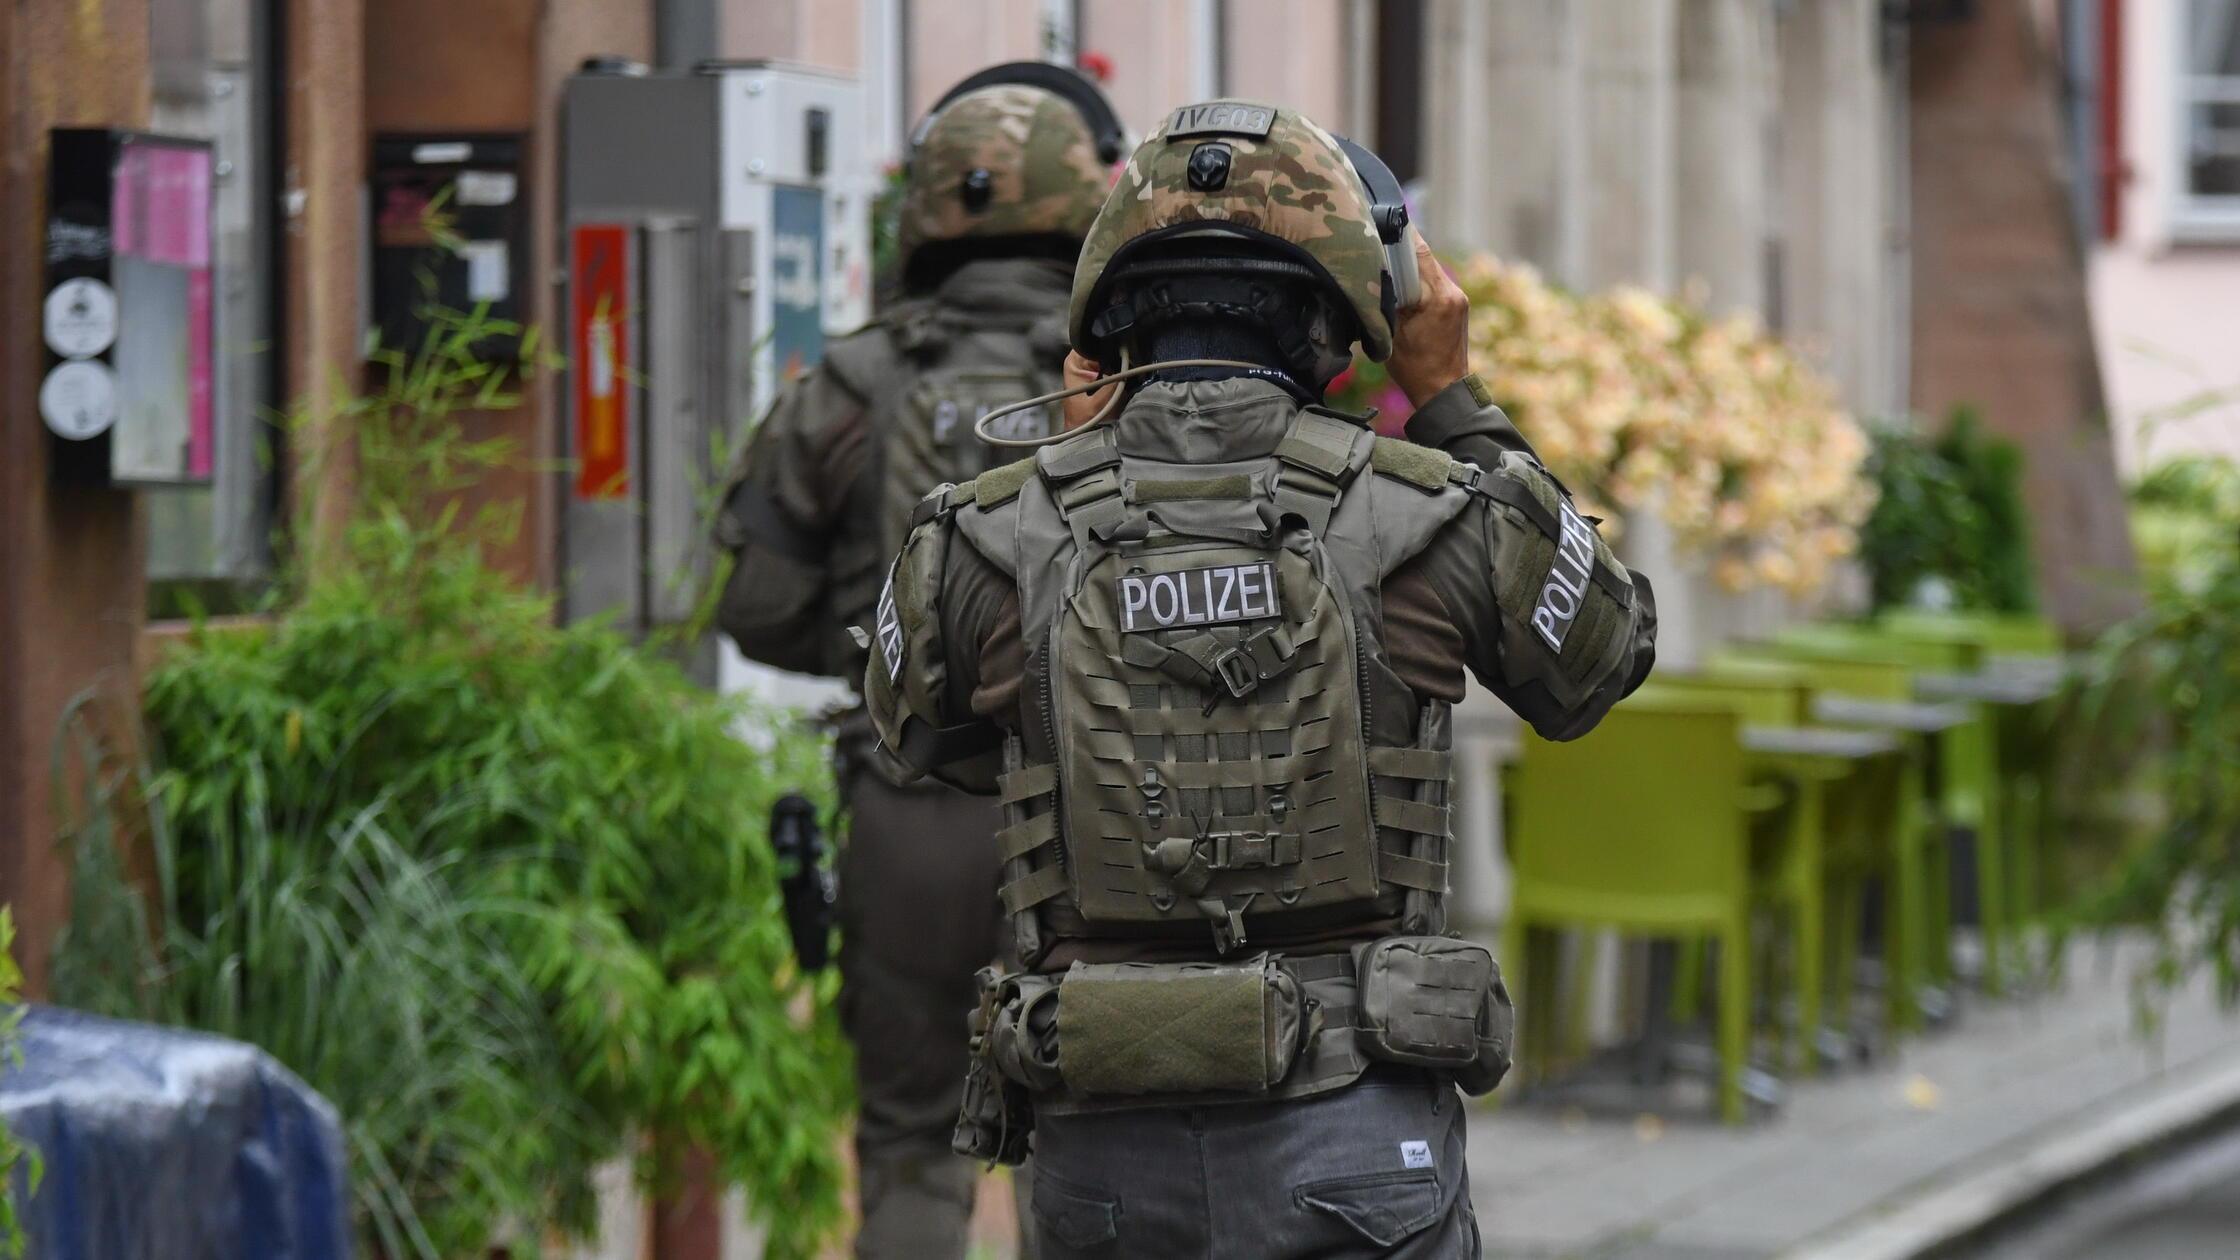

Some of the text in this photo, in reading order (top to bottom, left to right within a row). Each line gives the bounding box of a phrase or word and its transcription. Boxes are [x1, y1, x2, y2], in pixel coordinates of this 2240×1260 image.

[1175, 106, 1268, 131] IVG03
[933, 399, 1050, 445] PLIZEI
[1122, 564, 1276, 630] POLIZEI
[1535, 502, 1595, 648] POLIZEI
[876, 562, 904, 682] LIZEI
